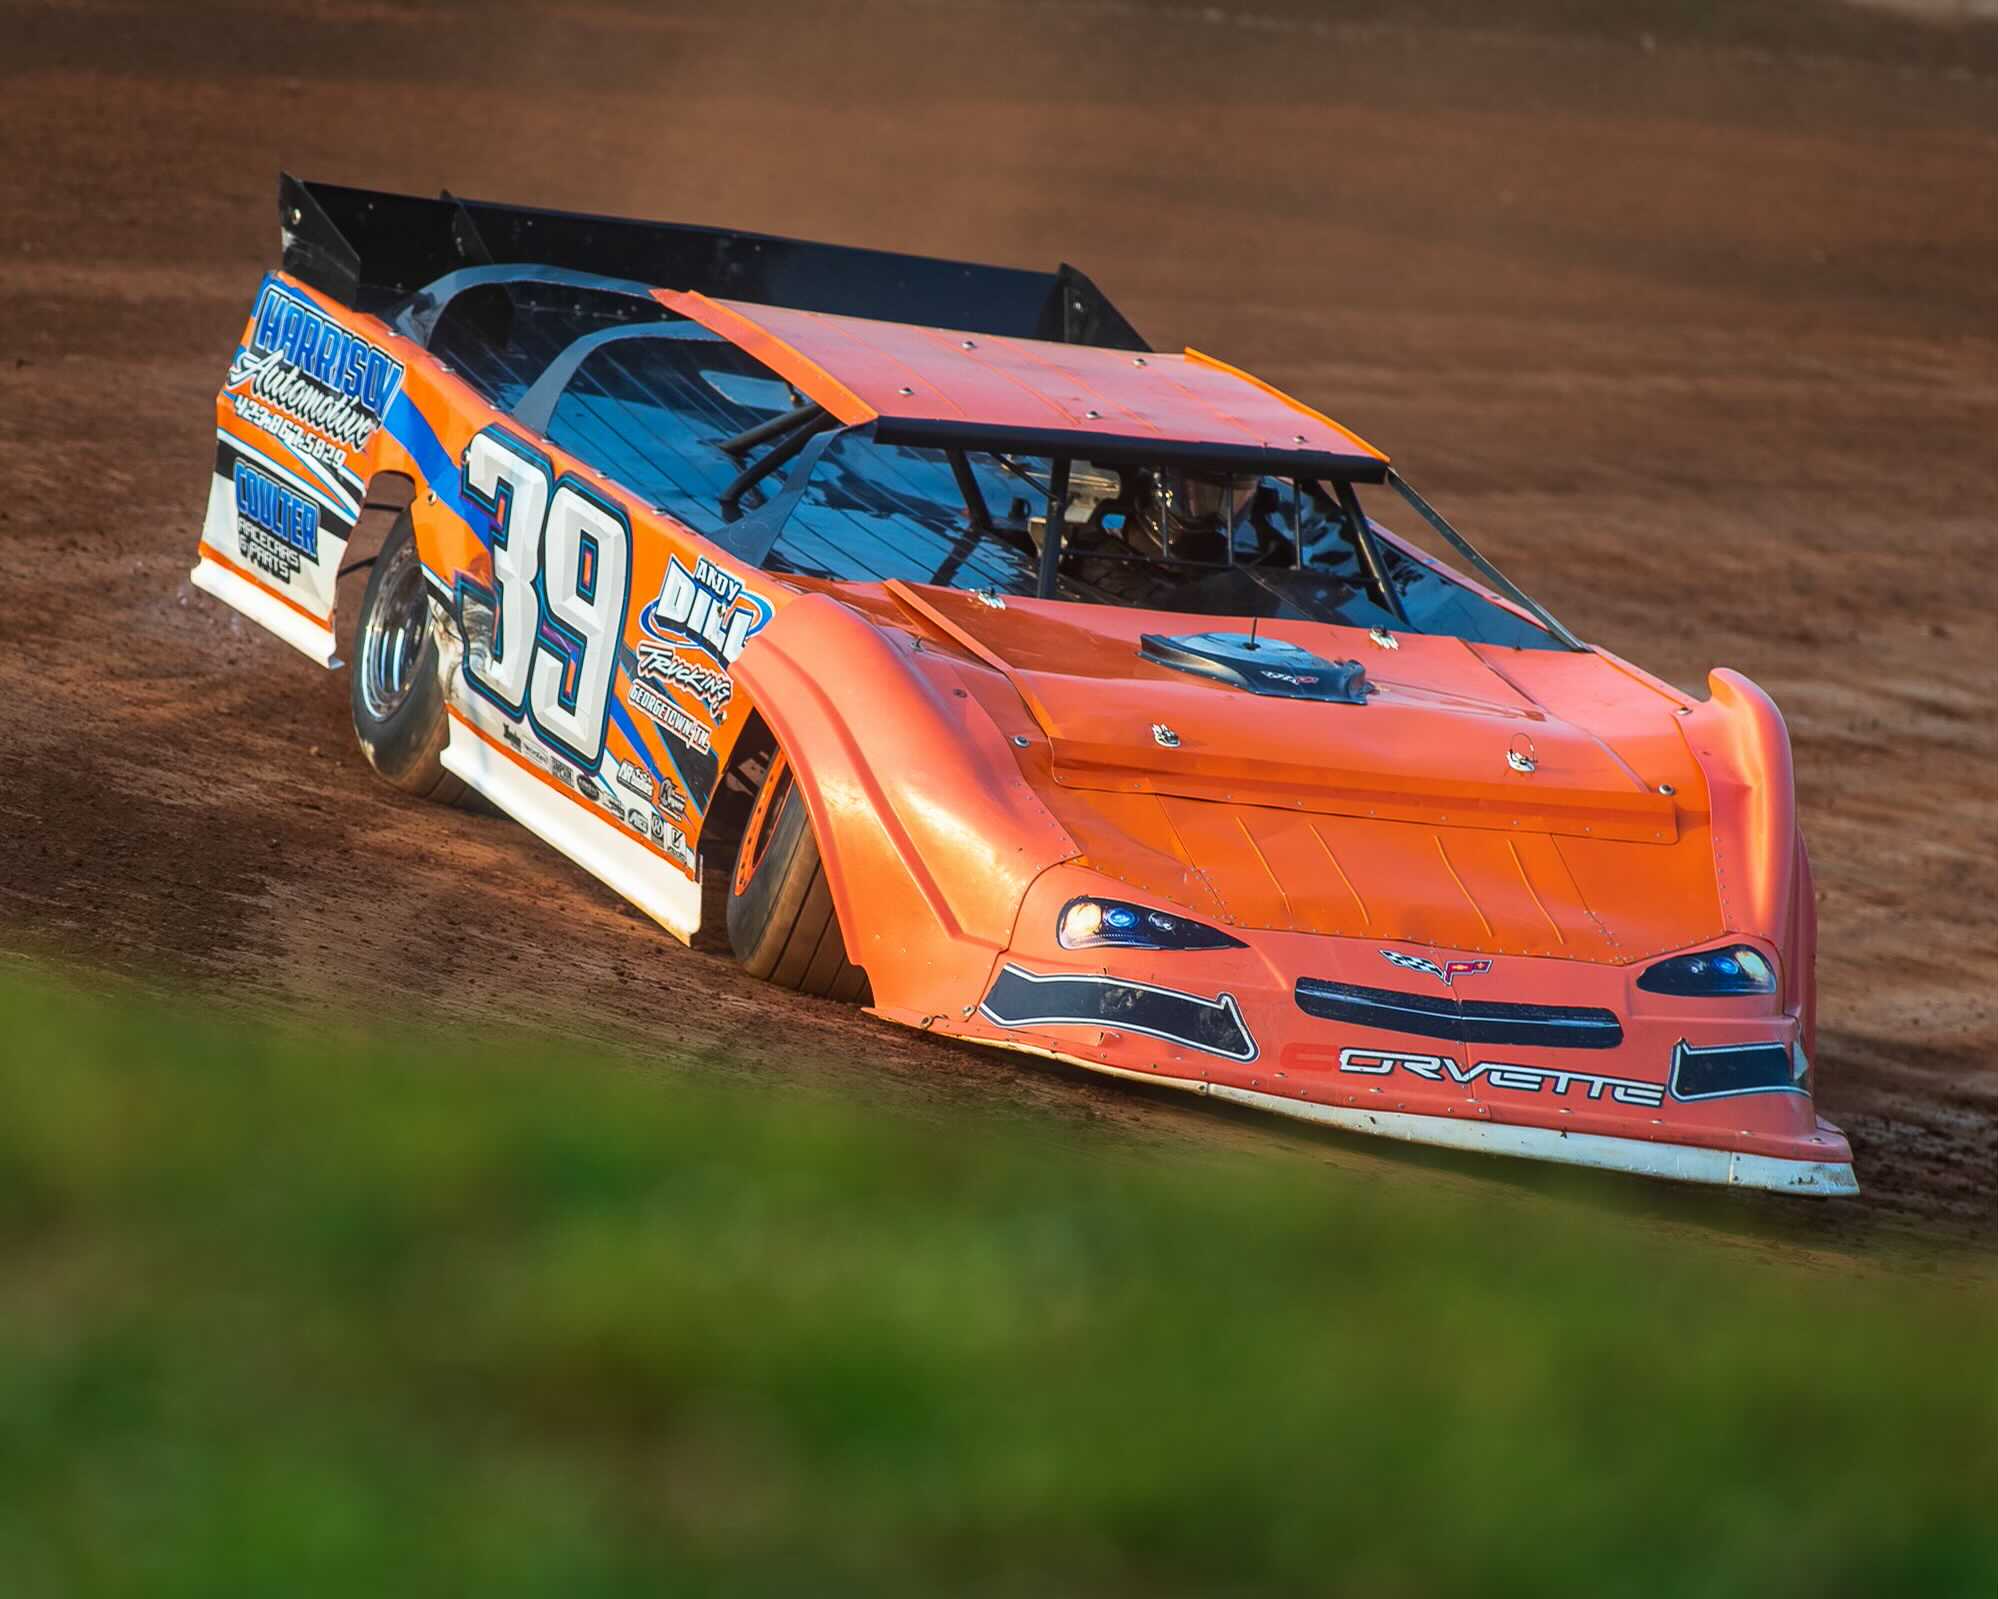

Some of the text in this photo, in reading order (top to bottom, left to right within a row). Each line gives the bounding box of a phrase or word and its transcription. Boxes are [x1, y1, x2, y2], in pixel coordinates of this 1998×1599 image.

[226, 349, 379, 451] Automotive
[233, 461, 319, 560] COULTER
[249, 541, 290, 581] PARTS
[462, 425, 632, 774] 39
[655, 557, 753, 665] DILL
[694, 559, 742, 602] ANDY
